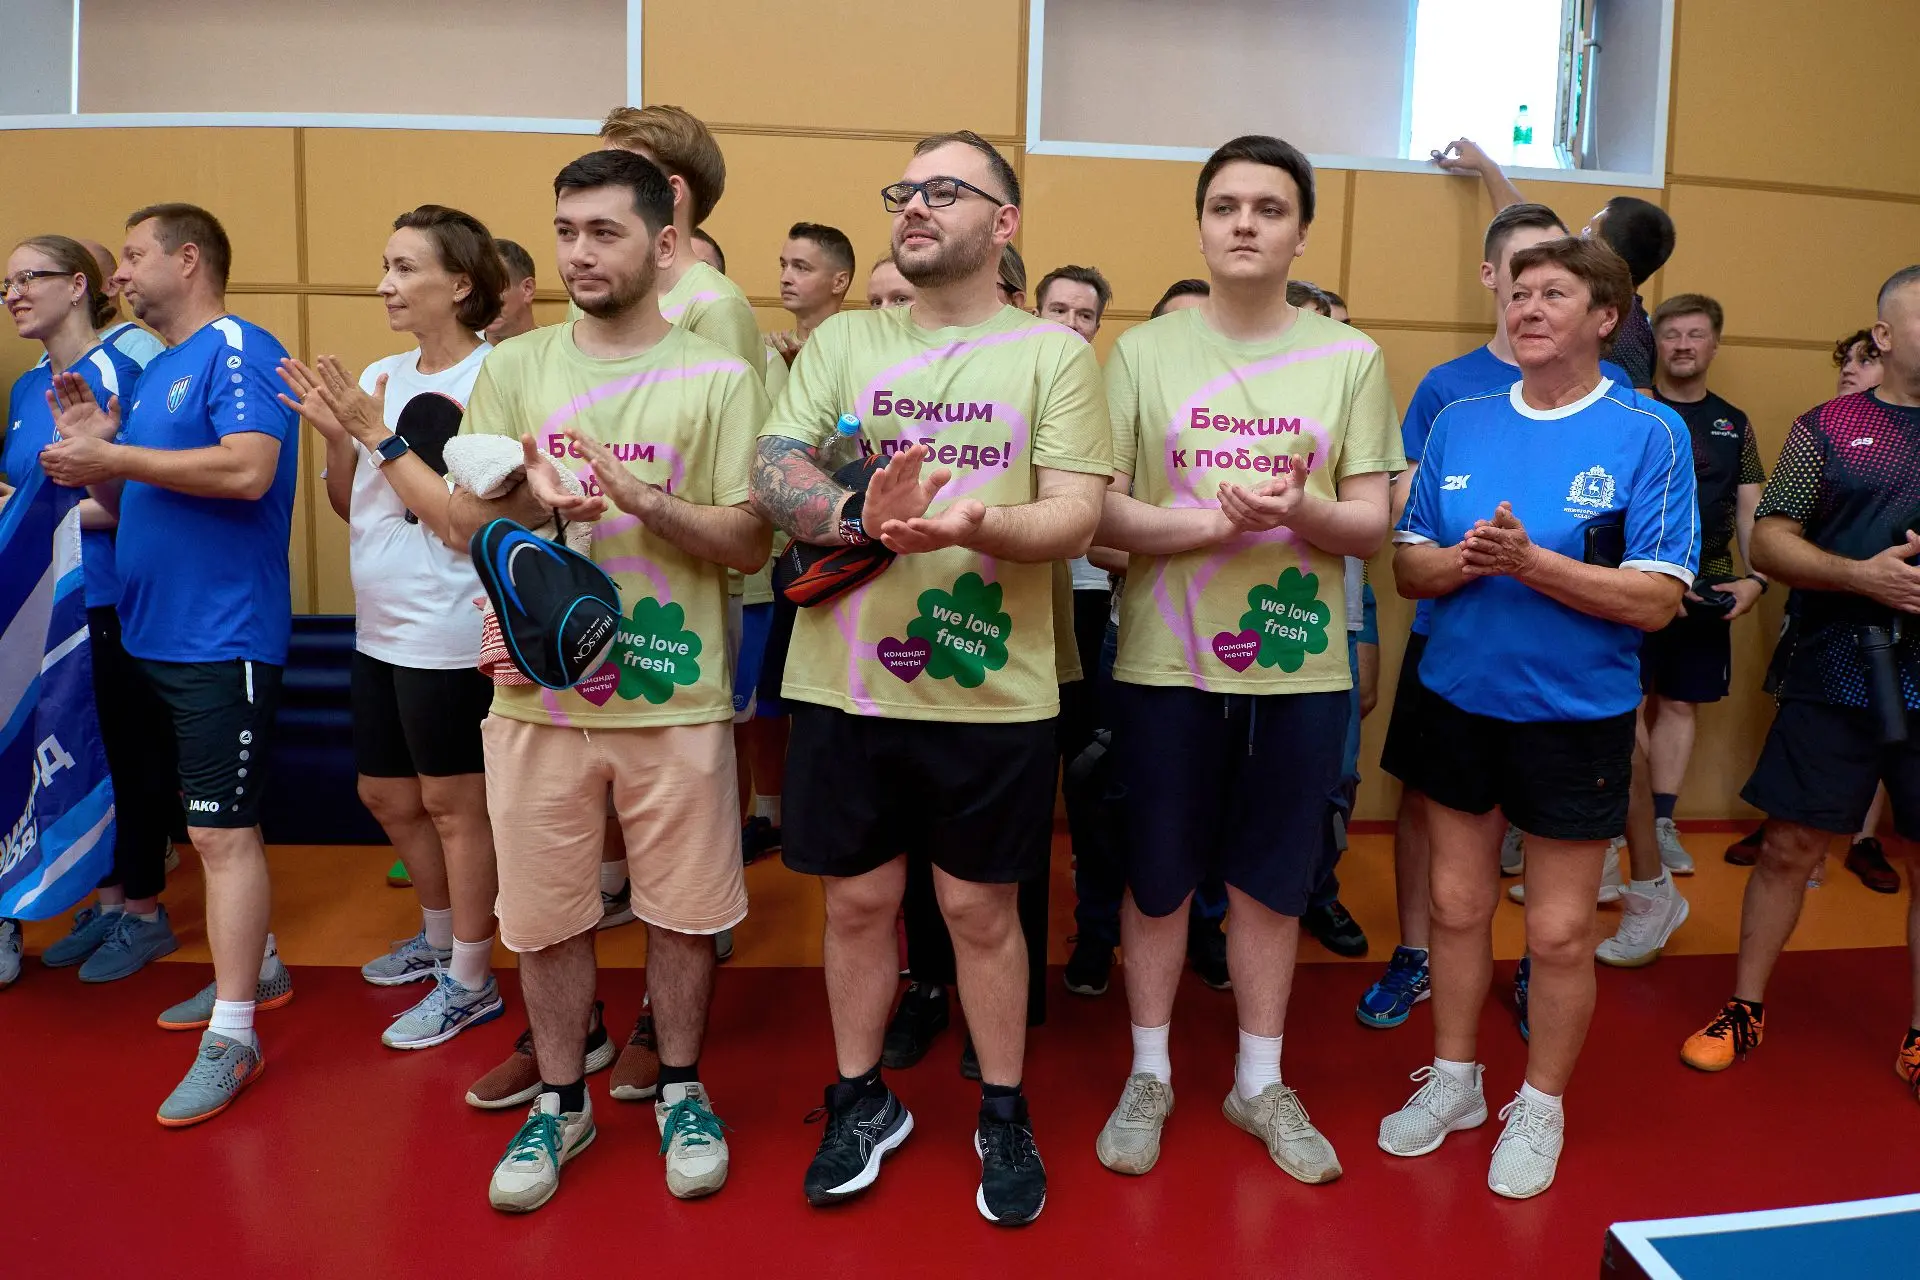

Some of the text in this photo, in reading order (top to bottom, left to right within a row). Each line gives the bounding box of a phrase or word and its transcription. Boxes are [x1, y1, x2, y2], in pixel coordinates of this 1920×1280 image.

[872, 391, 993, 423] Бежим
[1190, 407, 1301, 436] Бежим
[548, 433, 655, 463] Беим
[858, 438, 875, 458] к
[1172, 447, 1315, 477] к побед!
[932, 604, 1000, 638] we love
[1260, 598, 1319, 625] we love
[573, 615, 613, 664] HUIESON
[616, 630, 689, 656] we love
[936, 628, 987, 657] fresh
[1264, 618, 1308, 643] fresh
[883, 649, 926, 659] команда
[1218, 640, 1257, 652] команда
[1224, 650, 1253, 659] мечты
[623, 650, 676, 674] fresh
[890, 659, 921, 667] мечты
[579, 673, 615, 685] оманда
[582, 682, 613, 694] мечты
[189, 799, 220, 813] JAKO
